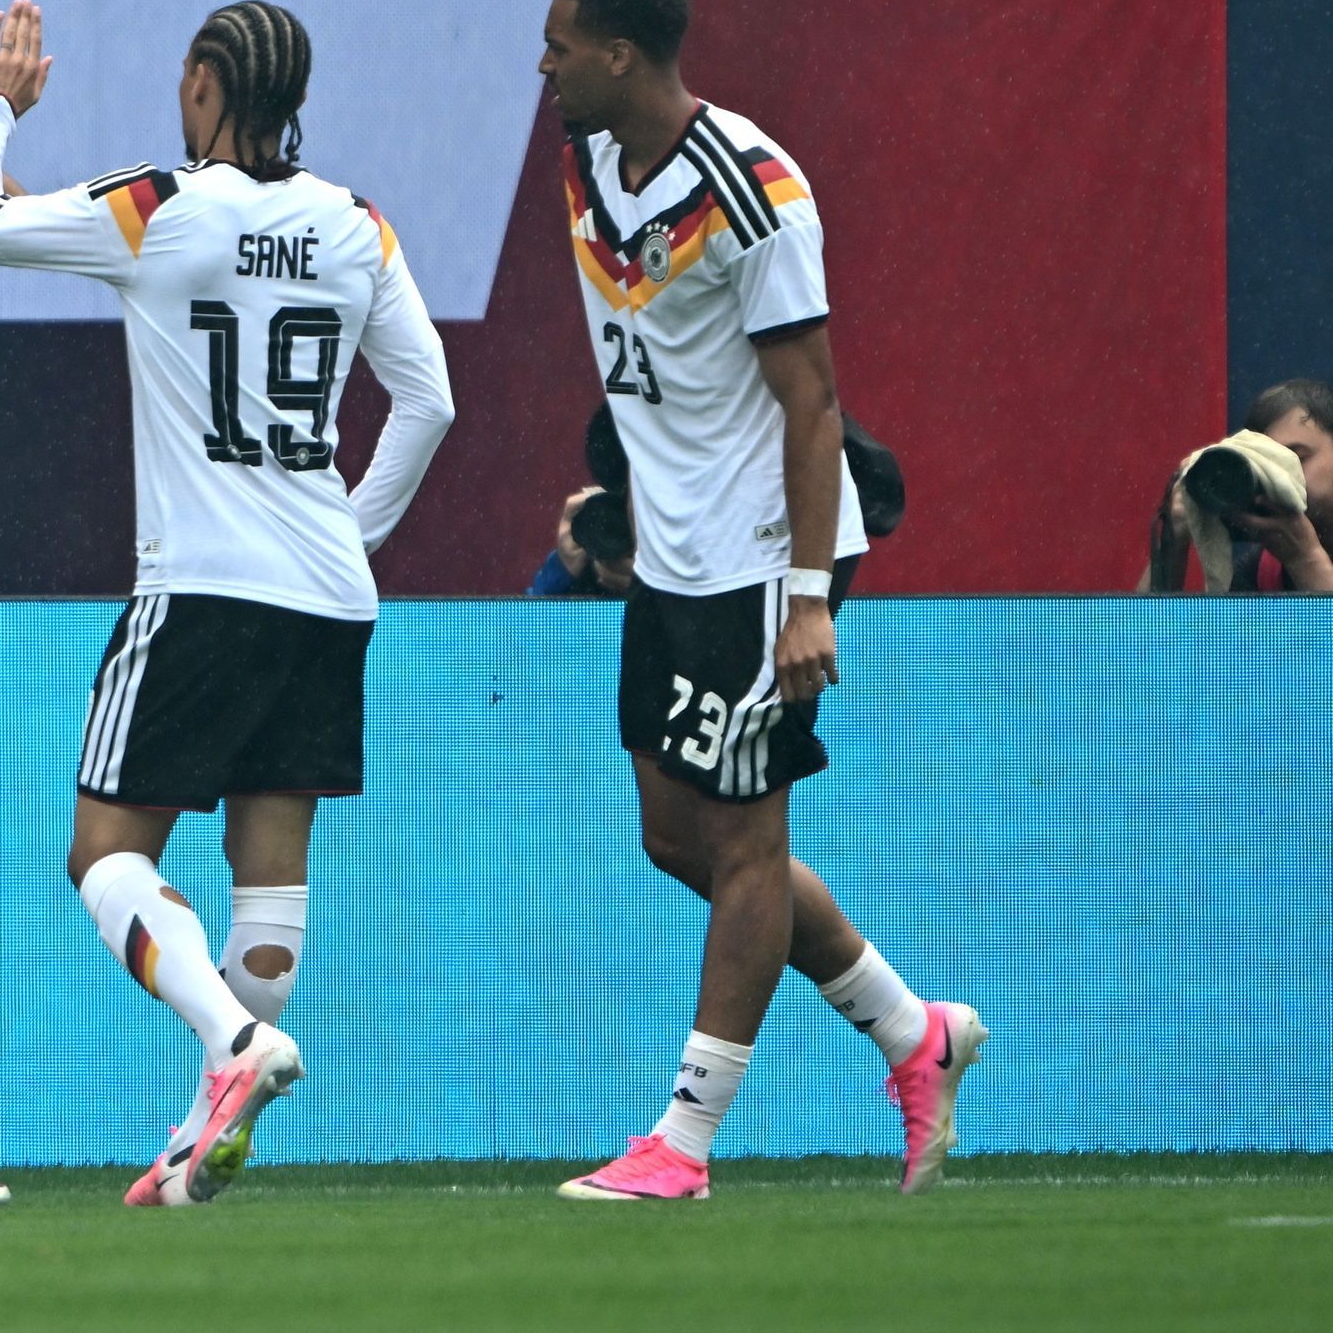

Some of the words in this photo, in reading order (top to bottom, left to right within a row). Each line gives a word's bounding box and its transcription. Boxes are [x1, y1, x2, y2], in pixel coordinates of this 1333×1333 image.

[236, 228, 320, 282] SANÉ
[189, 299, 343, 472] 19
[603, 321, 663, 406] 23
[679, 1062, 708, 1078] FB
